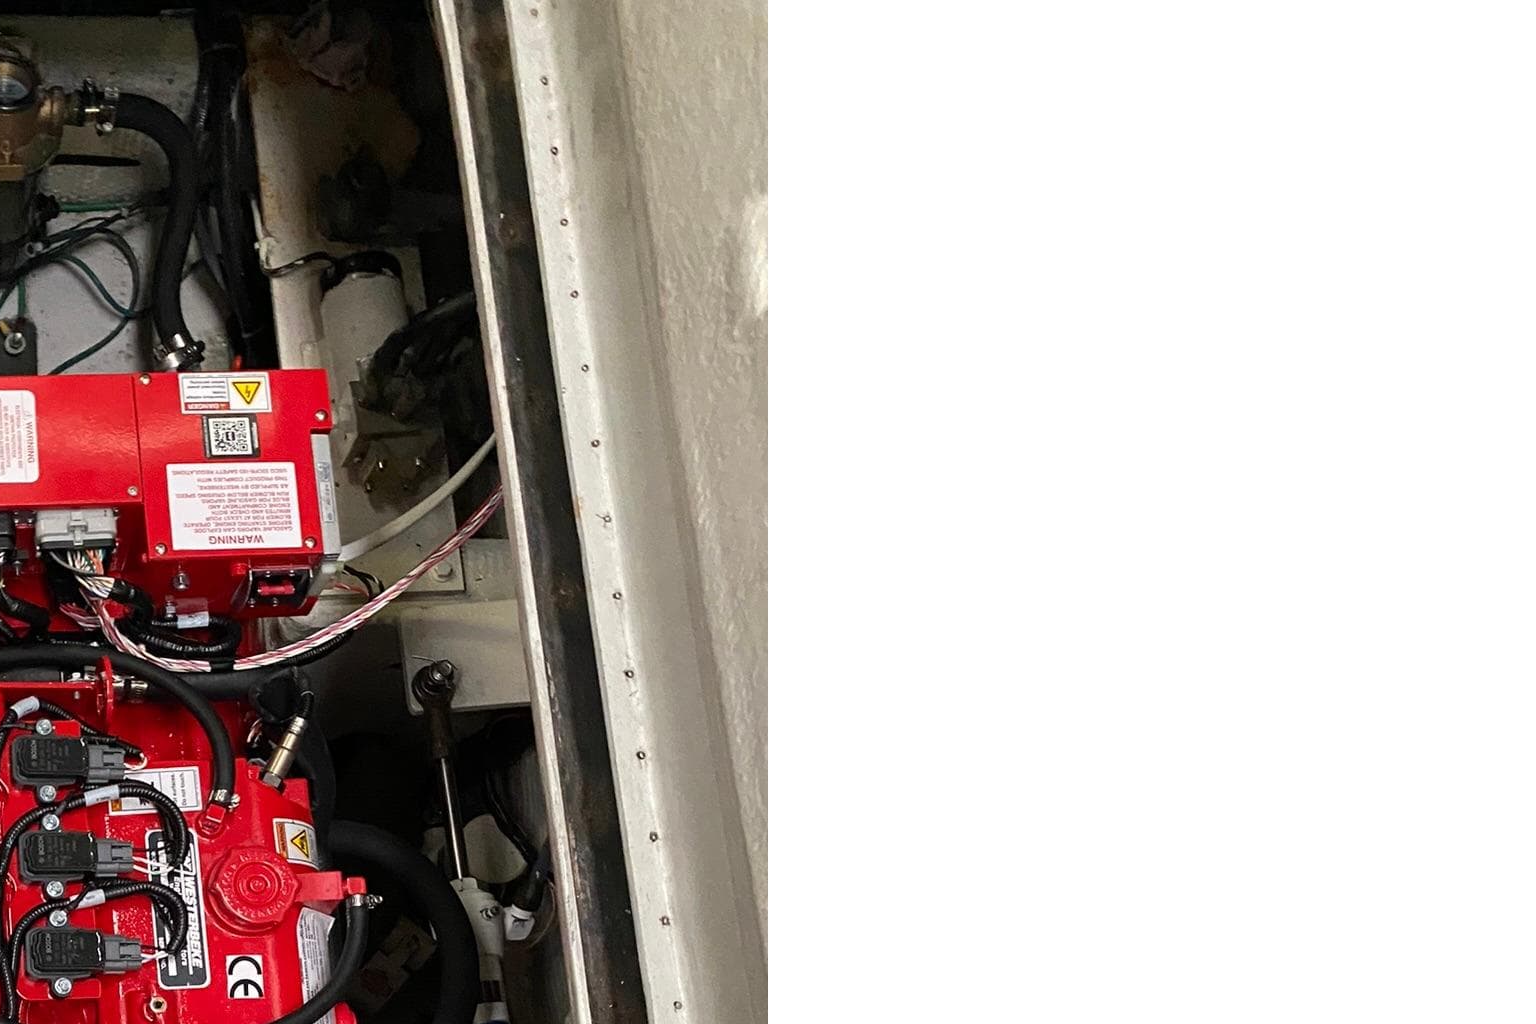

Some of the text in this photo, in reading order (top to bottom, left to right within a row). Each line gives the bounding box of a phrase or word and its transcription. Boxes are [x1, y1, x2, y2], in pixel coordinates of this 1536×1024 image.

[25, 422, 35, 463] WARNING
[209, 535, 264, 544] WARNING
[184, 877, 203, 969] WESTERBEKE
[228, 955, 264, 998] CE
